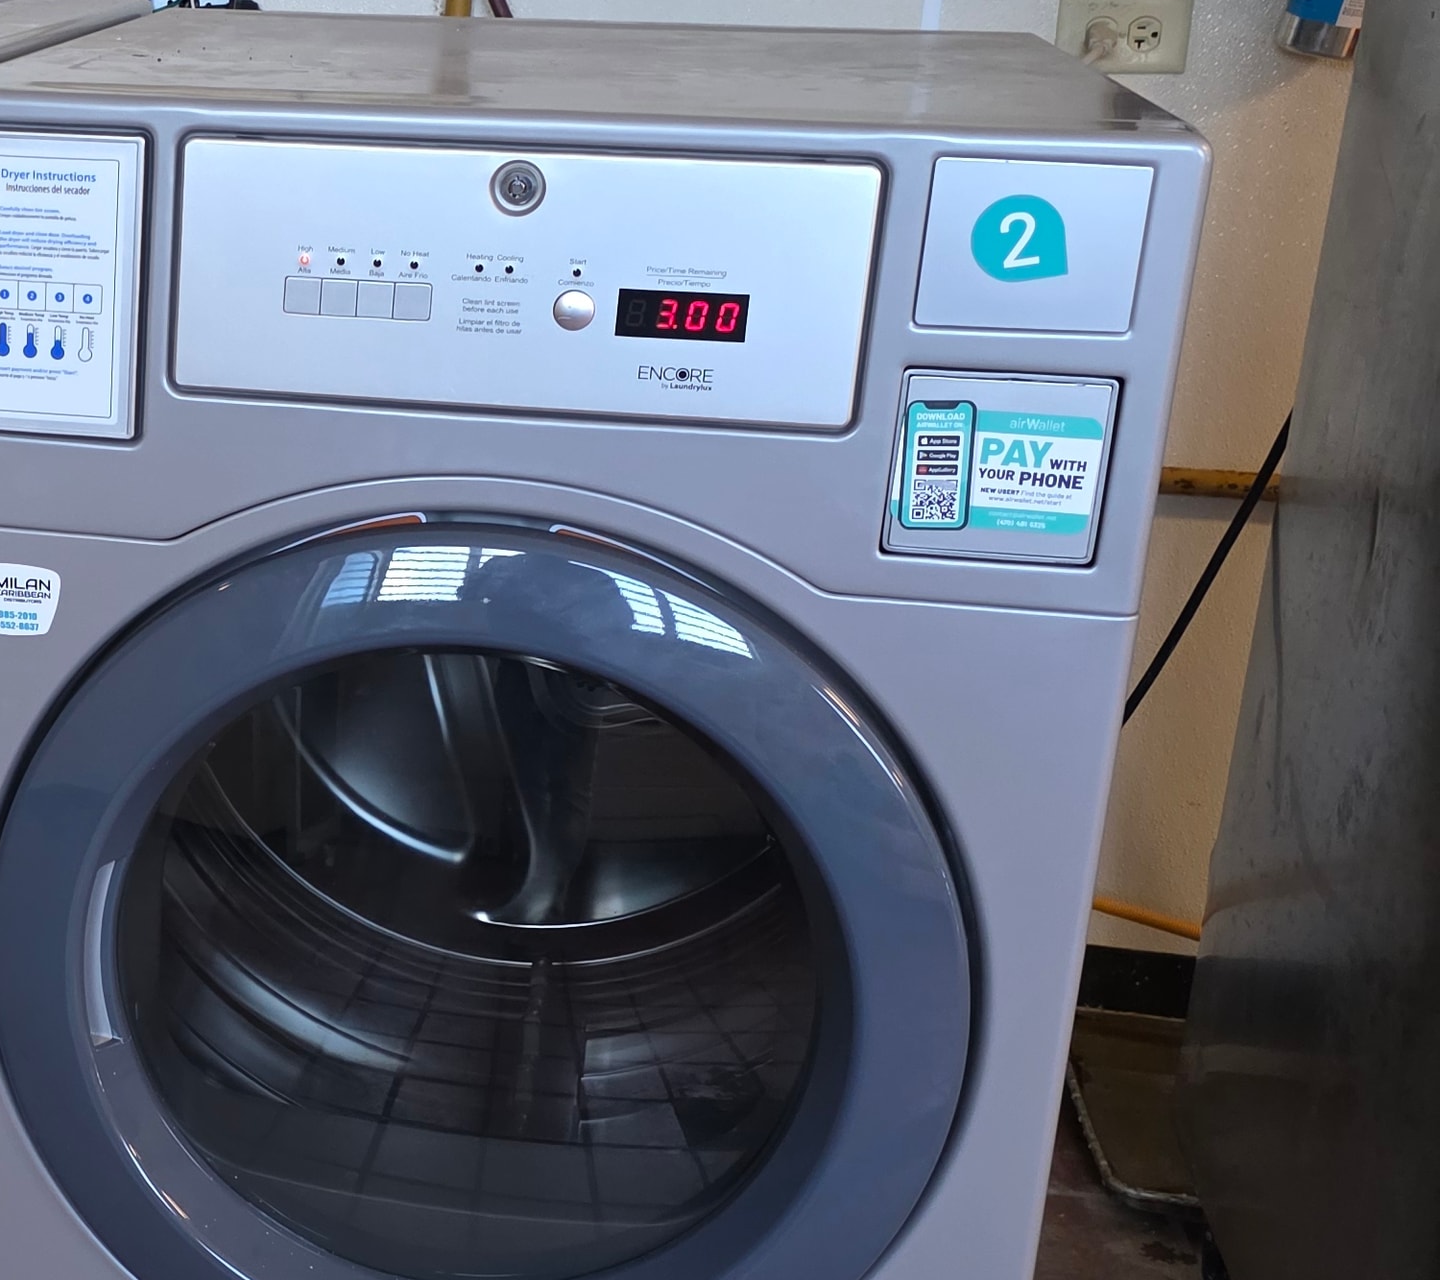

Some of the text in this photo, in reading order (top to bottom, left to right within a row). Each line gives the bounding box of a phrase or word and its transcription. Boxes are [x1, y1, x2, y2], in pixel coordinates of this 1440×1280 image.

[1, 168, 96, 183] Dryer Instructions
[6, 183, 90, 196] Instrucciones del secador
[999, 211, 1040, 269] 2
[298, 245, 313, 253] High
[328, 246, 355, 254] Medium
[400, 249, 429, 258] No Heat
[466, 253, 494, 262] Heating
[496, 254, 524, 263] Cooling
[369, 269, 384, 278] Baja
[398, 271, 413, 279] Aire
[646, 266, 727, 278] Price/Time Remaining
[451, 274, 492, 283] Calentando
[494, 276, 528, 284] Enfriando
[558, 279, 595, 287] Comienzo
[658, 279, 711, 288] Precio/Tiempo
[656, 299, 740, 332] 3.00
[458, 317, 484, 326] Limpiar
[474, 326, 494, 334] antes
[637, 365, 714, 383] ENCORE
[670, 383, 712, 392] Laundrylux
[916, 412, 966, 421] DOWNLOAD
[1009, 417, 1066, 432] airWallet
[979, 437, 1087, 473] PAY WITH
[978, 467, 1085, 490] YOUR PHONE
